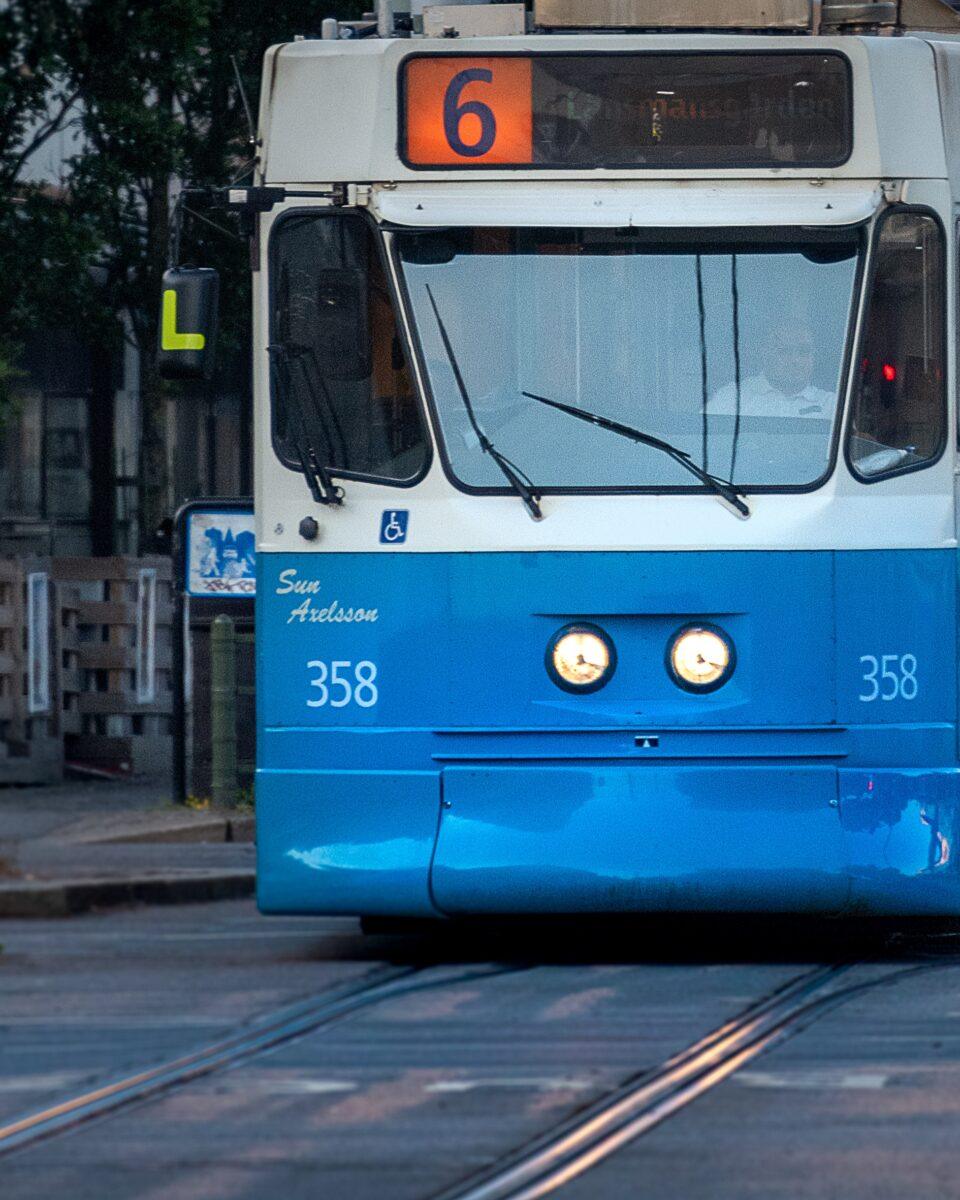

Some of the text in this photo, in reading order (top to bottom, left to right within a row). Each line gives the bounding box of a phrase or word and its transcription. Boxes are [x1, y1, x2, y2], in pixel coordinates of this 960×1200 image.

[442, 68, 497, 158] 6
[276, 568, 321, 594] Sun
[287, 598, 379, 624] Axelsson
[306, 660, 378, 708] 358
[859, 653, 918, 702] 358
